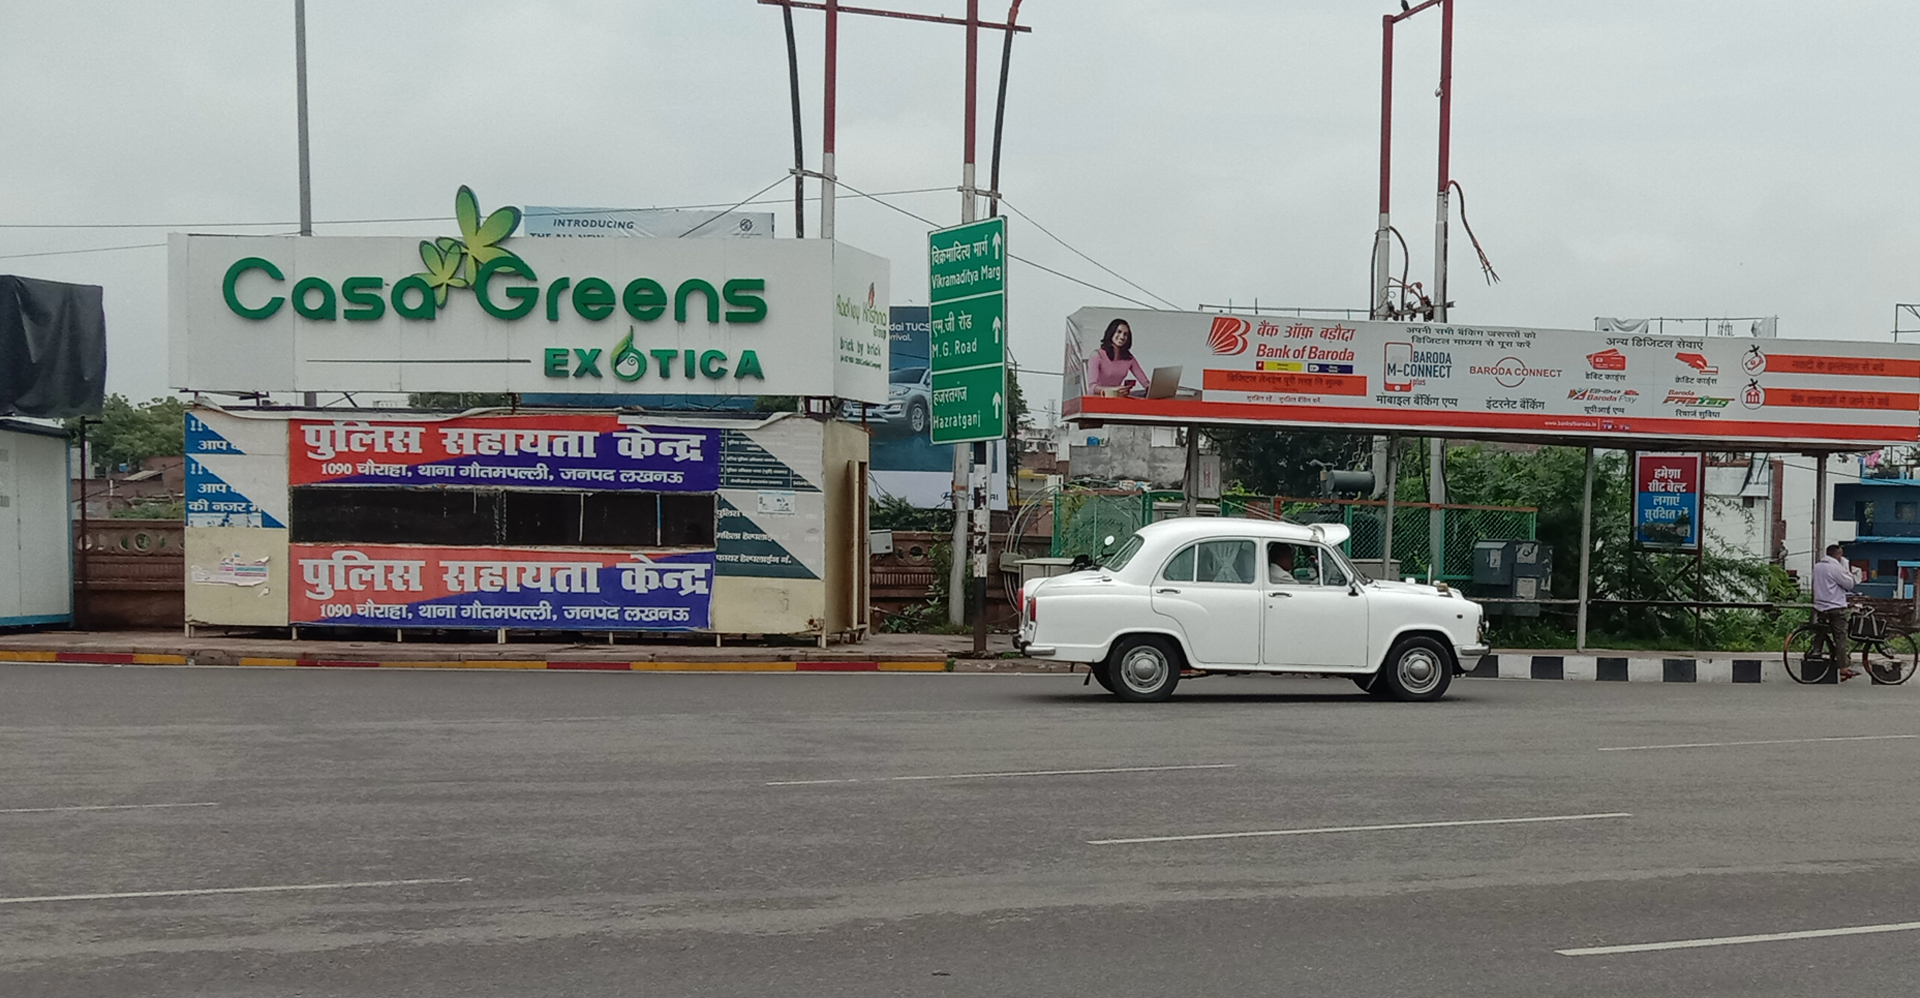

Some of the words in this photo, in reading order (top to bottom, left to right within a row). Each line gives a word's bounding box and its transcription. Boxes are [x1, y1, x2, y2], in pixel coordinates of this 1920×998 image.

[553, 219, 635, 229] INTRODUCING
[932, 240, 971, 266] विक्रमादित्य
[973, 234, 989, 257] मार्ग
[932, 269, 979, 289] Vikramaditya
[981, 265, 1001, 281] Marg
[222, 256, 437, 320] Casa
[476, 255, 768, 322] Greens
[958, 310, 972, 330] रोड
[1257, 320, 1279, 337] बैंक
[1320, 324, 1356, 343] बड़ौदा
[1406, 326, 1432, 334] अपनी
[1524, 331, 1536, 339] को
[932, 341, 952, 358] M.G.
[955, 337, 977, 355] Road
[1411, 335, 1450, 345] डिजिटल
[1485, 338, 1494, 347] से
[1606, 338, 1628, 346] अन्य
[1631, 336, 1673, 348] डिजिटल
[544, 335, 765, 381] EXOTICA
[1256, 343, 1290, 359] Bank
[1293, 345, 1307, 359] of
[1308, 345, 1355, 361] Baroda
[1413, 351, 1452, 364] BARODA
[1387, 363, 1452, 378] M-CONNECT
[1469, 365, 1512, 376] BARODA
[1514, 367, 1563, 378] CONNECT
[1376, 392, 1411, 406] मोबाइल
[1485, 396, 1517, 409] इंटरनेट
[1587, 394, 1617, 402] Baroda
[1618, 395, 1638, 404] Pay
[933, 410, 981, 430] Hazratganj
[197, 440, 227, 450] आप
[300, 421, 426, 460] पुलिस
[438, 427, 600, 458] सहायता
[612, 425, 706, 462] केन्द्र
[321, 463, 352, 475] 1090
[356, 459, 412, 478] चौराहा,
[418, 464, 455, 477] थाना
[459, 461, 554, 481] गौतमपल्ली,
[559, 467, 616, 482] जनपद
[619, 469, 684, 483] लखनऊ
[1654, 466, 1681, 479] हमेशा
[197, 483, 227, 493] आप
[1647, 480, 1666, 492] सीट
[187, 499, 209, 511] की
[212, 502, 247, 512] नजर
[1653, 493, 1680, 506] लगाएं
[1644, 507, 1676, 521] सुरक्षित
[298, 550, 426, 600] पुलिस
[439, 560, 603, 592] सहायता
[616, 554, 711, 597] केन्द्र
[320, 603, 351, 618] 1090
[356, 598, 413, 620] चौराहा,
[418, 604, 457, 619] थाना
[460, 599, 557, 622] गौतमपल्ली,
[562, 606, 620, 621] जनपद
[623, 607, 690, 622] लखनऊ
